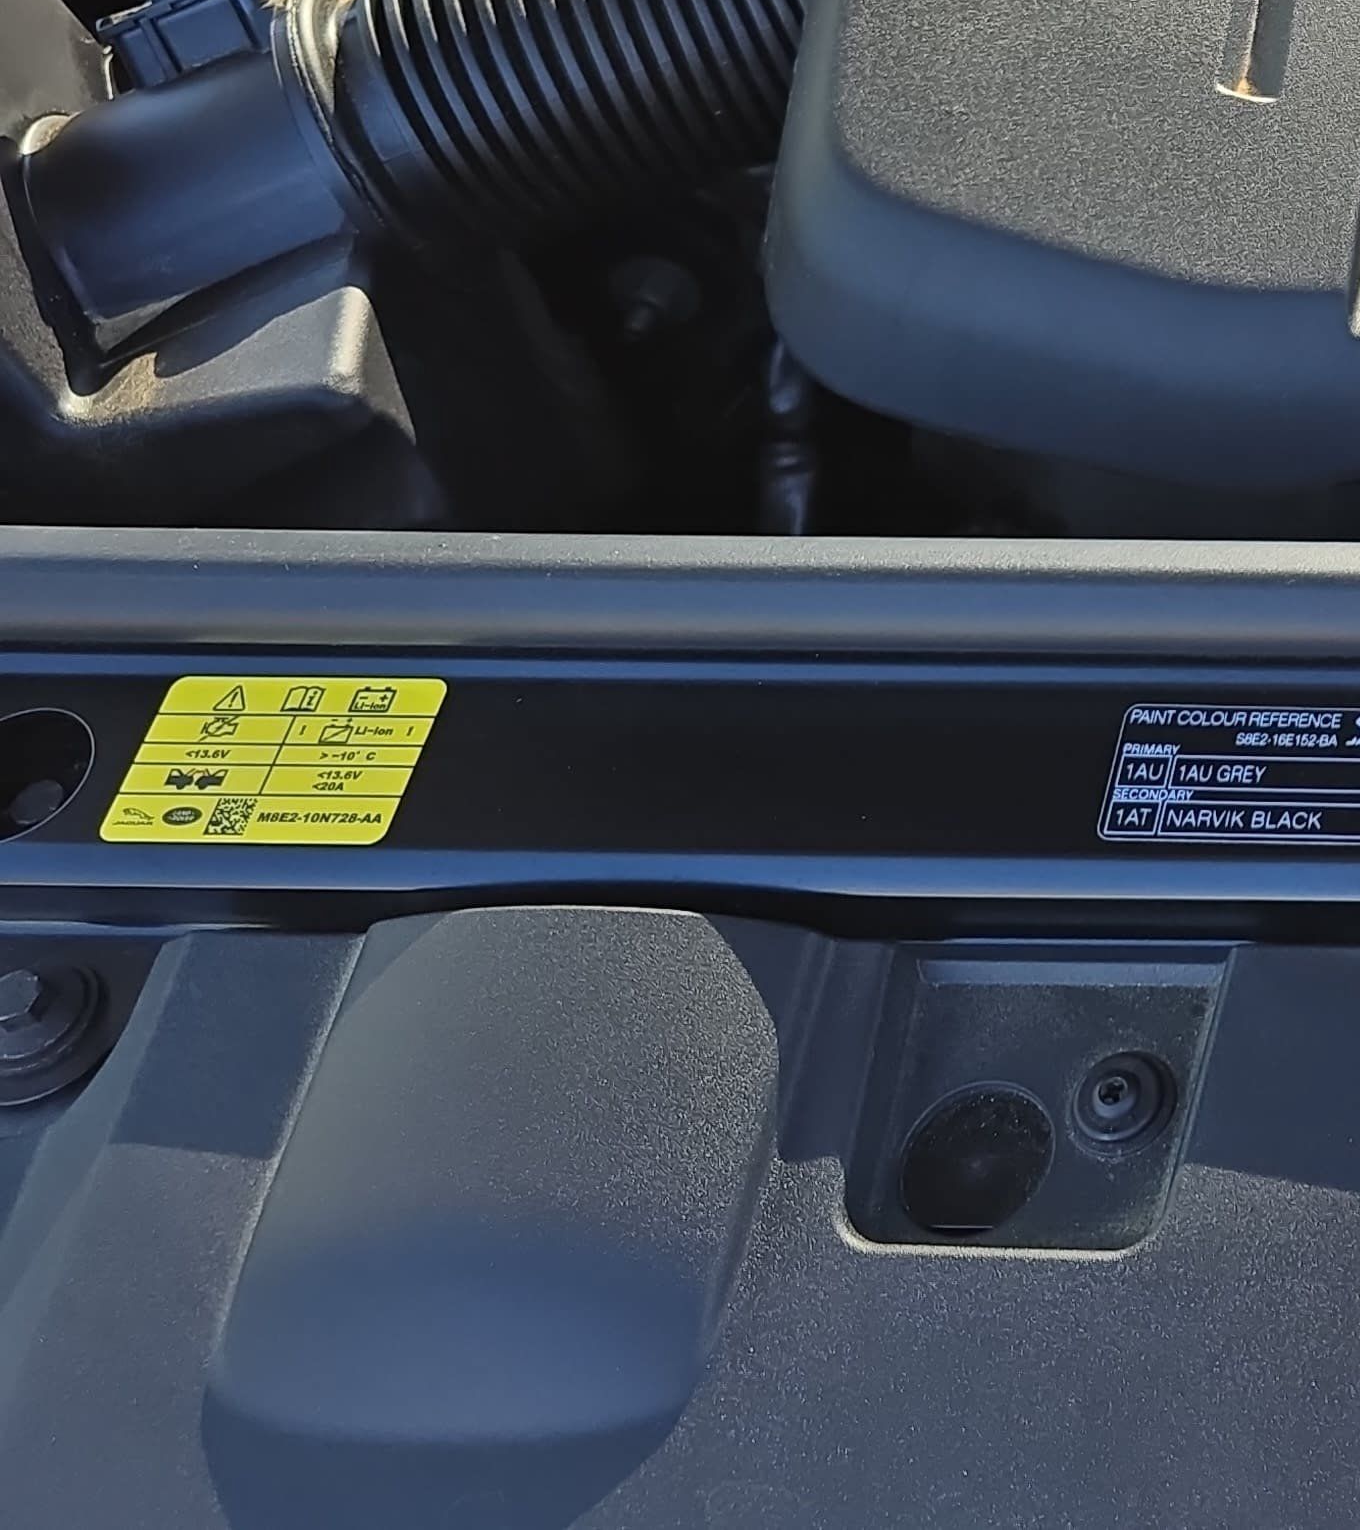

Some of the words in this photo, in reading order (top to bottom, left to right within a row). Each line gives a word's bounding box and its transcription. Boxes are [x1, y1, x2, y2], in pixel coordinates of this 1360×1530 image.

[1130, 709, 1176, 725] PAINT
[1177, 710, 1247, 726] COLOUR
[1247, 711, 1343, 729] REFERENCE
[1122, 743, 1181, 755] PRIMARY
[1126, 762, 1165, 782] 1AU
[1179, 763, 1214, 783] 1AU
[1216, 764, 1267, 784] GREY
[1112, 788, 1195, 801] SECONDARY
[1116, 808, 1154, 827] 1AT
[1165, 808, 1246, 829] NARVIK
[1250, 810, 1324, 831] BLACK
